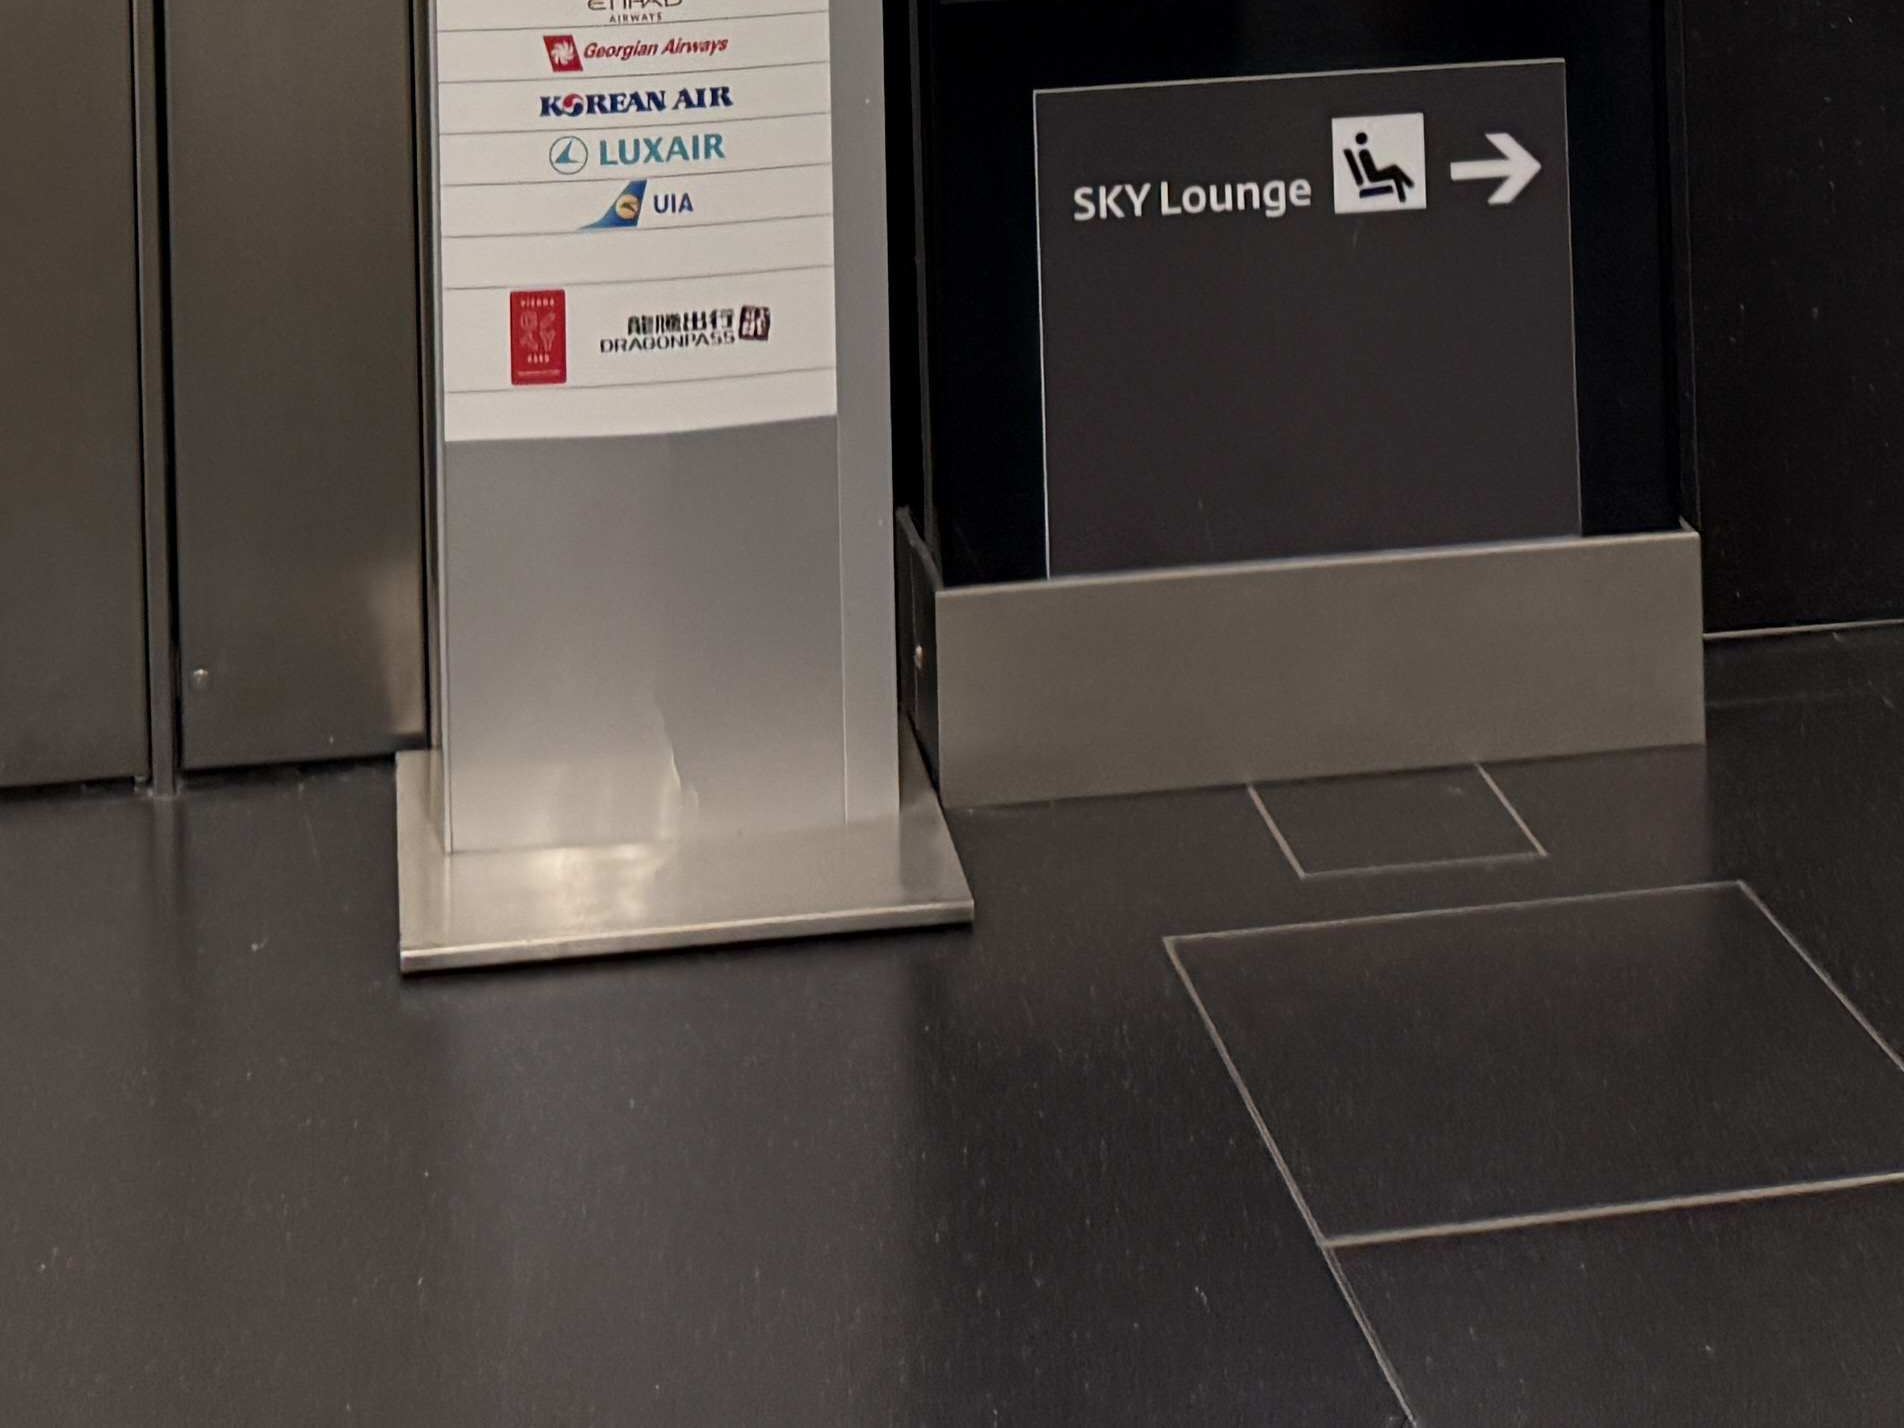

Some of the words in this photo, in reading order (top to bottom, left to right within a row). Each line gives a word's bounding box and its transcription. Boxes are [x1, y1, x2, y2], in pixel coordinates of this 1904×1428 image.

[609, 11, 663, 24] AIRWAYS
[584, 40, 659, 61] Georgian
[661, 37, 729, 57] Airways
[539, 89, 667, 118] KOREAN
[671, 85, 734, 111] AIR
[599, 132, 726, 166] LUXAIR
[653, 192, 694, 215] UIA
[1072, 183, 1152, 222] SKY
[1159, 176, 1313, 219] Lounge
[599, 329, 736, 353] DRAGONPASS
